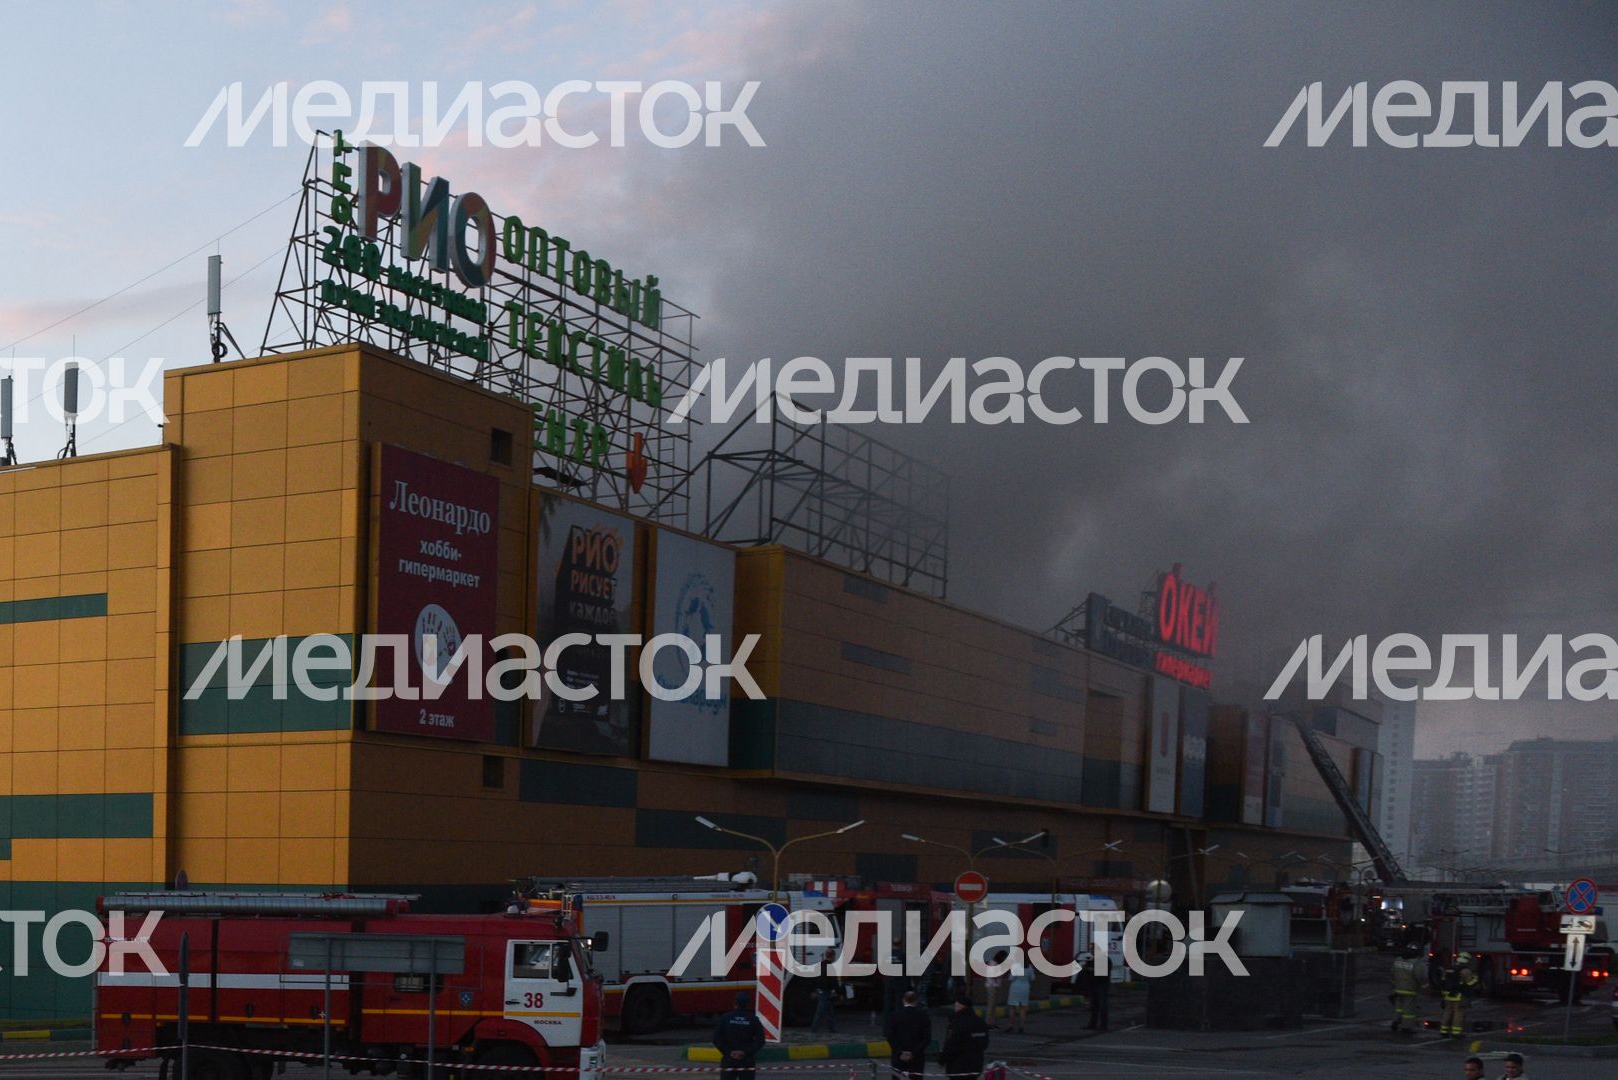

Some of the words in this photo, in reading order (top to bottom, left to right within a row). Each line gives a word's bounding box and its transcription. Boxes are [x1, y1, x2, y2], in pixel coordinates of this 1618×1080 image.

[357, 140, 496, 288] РИО
[503, 216, 661, 331] ОПТОВЫЙ
[504, 300, 661, 408] ТЕКСТИЛЬ
[501, 392, 609, 468] ЕНТР
[390, 480, 491, 536] Леонардо
[398, 558, 480, 588] гипермаркет
[419, 539, 462, 560] хобби-
[571, 525, 619, 573] РИО
[570, 569, 617, 600] РИСУЕТ
[419, 708, 426, 725] 2
[428, 712, 455, 728] этаж
[524, 992, 543, 1009] 38
